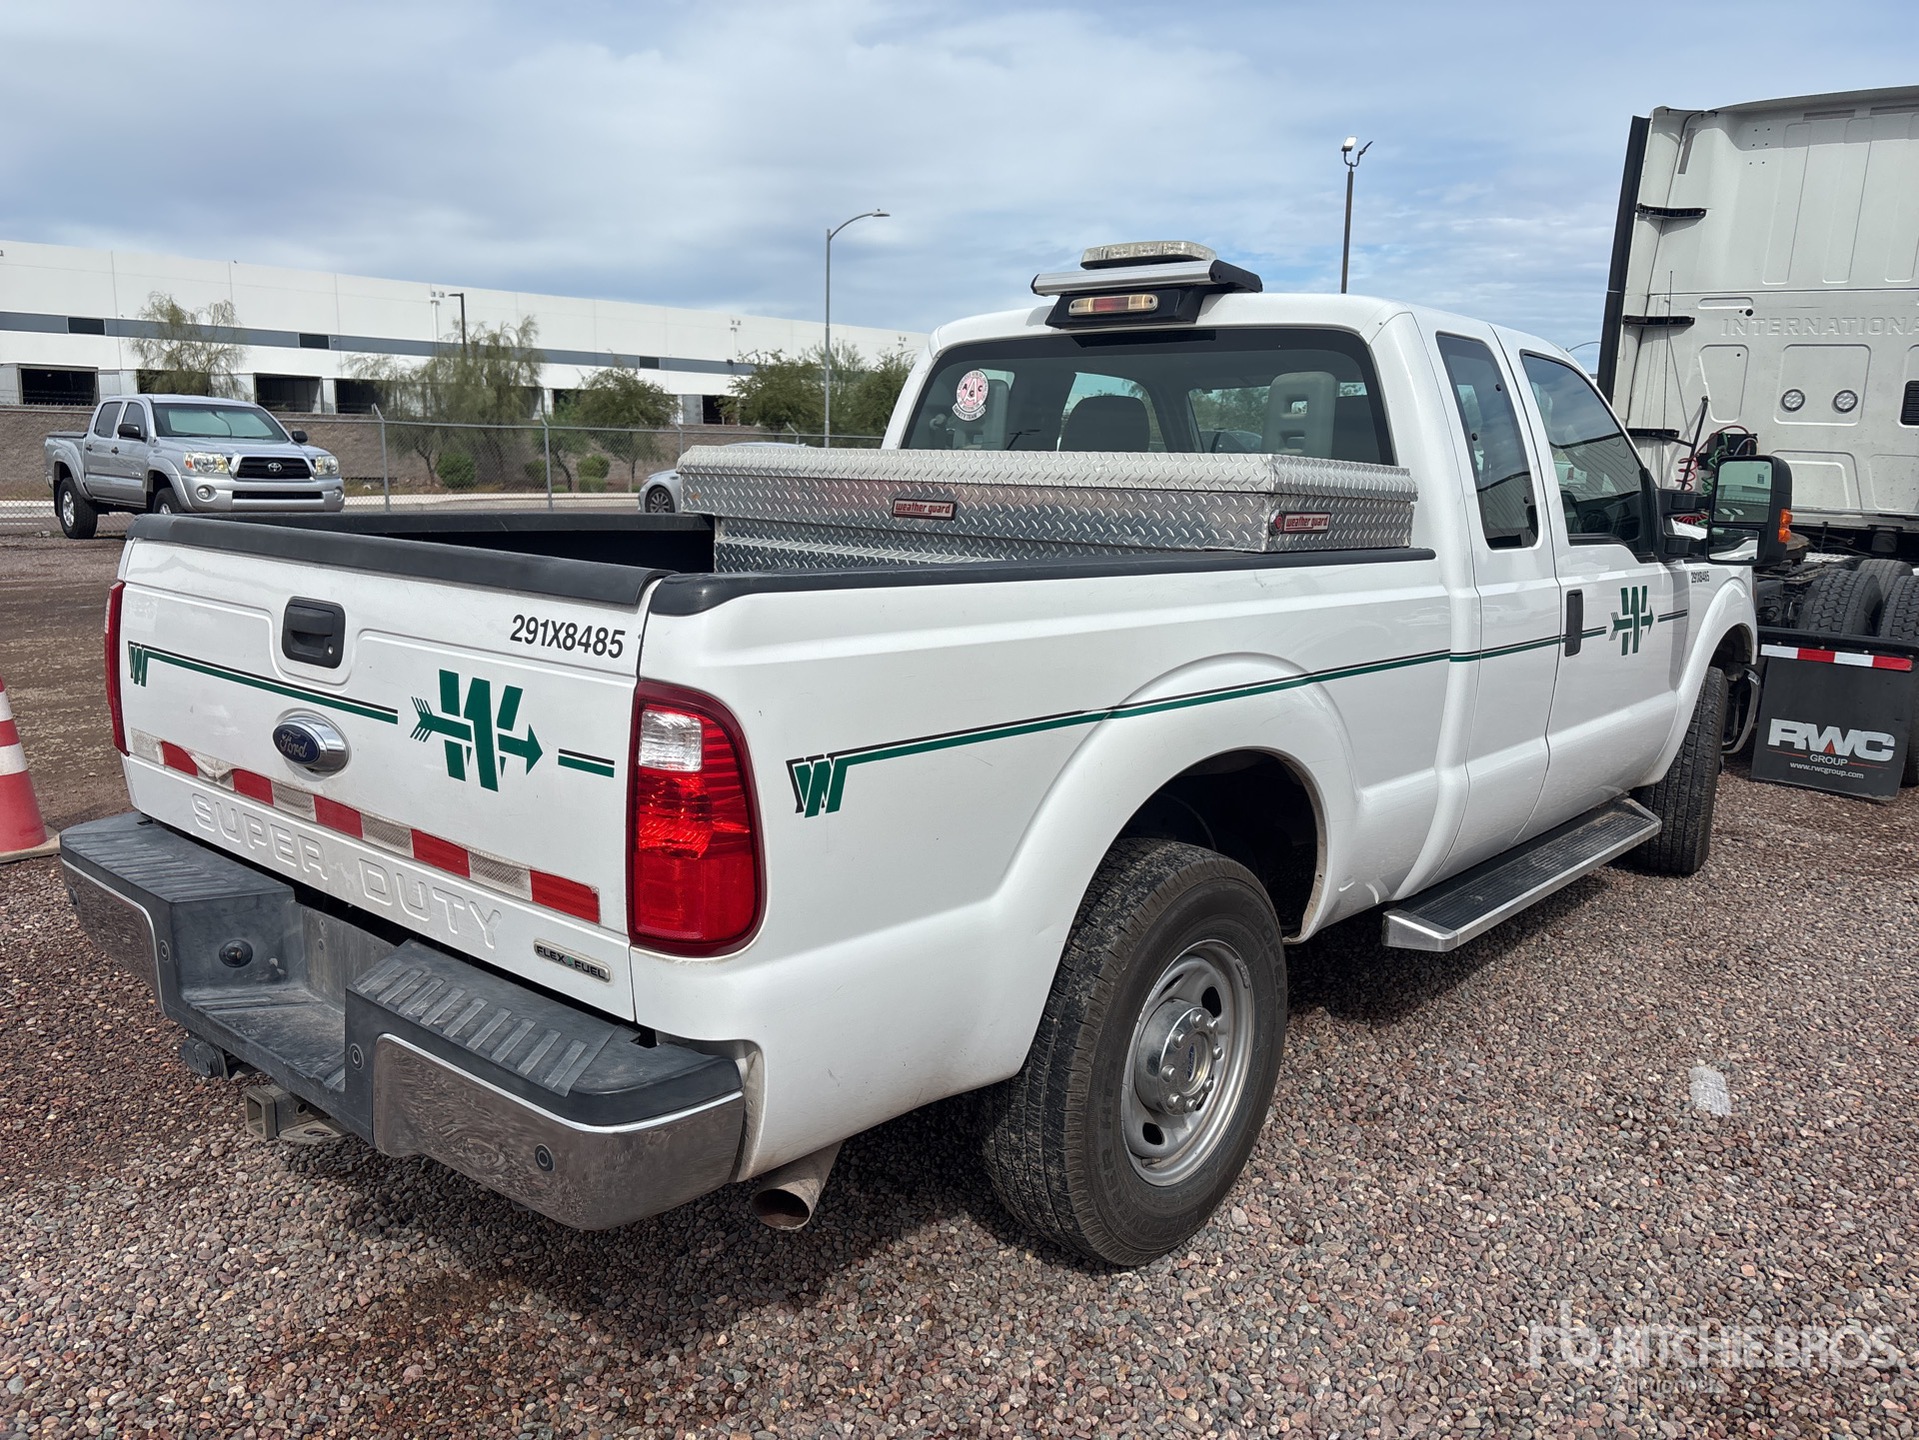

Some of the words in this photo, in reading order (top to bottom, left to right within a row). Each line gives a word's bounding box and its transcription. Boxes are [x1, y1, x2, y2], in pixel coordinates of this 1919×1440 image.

[895, 502, 927, 513] weather
[928, 504, 951, 514] guard
[1286, 516, 1311, 527] weather
[1311, 515, 1329, 527] guard
[510, 614, 626, 659] 291X8485
[280, 728, 308, 758] Ford
[1767, 718, 1896, 762] RWC
[1789, 762, 1865, 780] www.rwcgroup.com
[1809, 754, 1849, 767] GROUP
[191, 792, 329, 881] SUPER
[358, 857, 503, 950] DUTY
[536, 945, 567, 964] FLEX
[574, 960, 607, 980] FUEL
